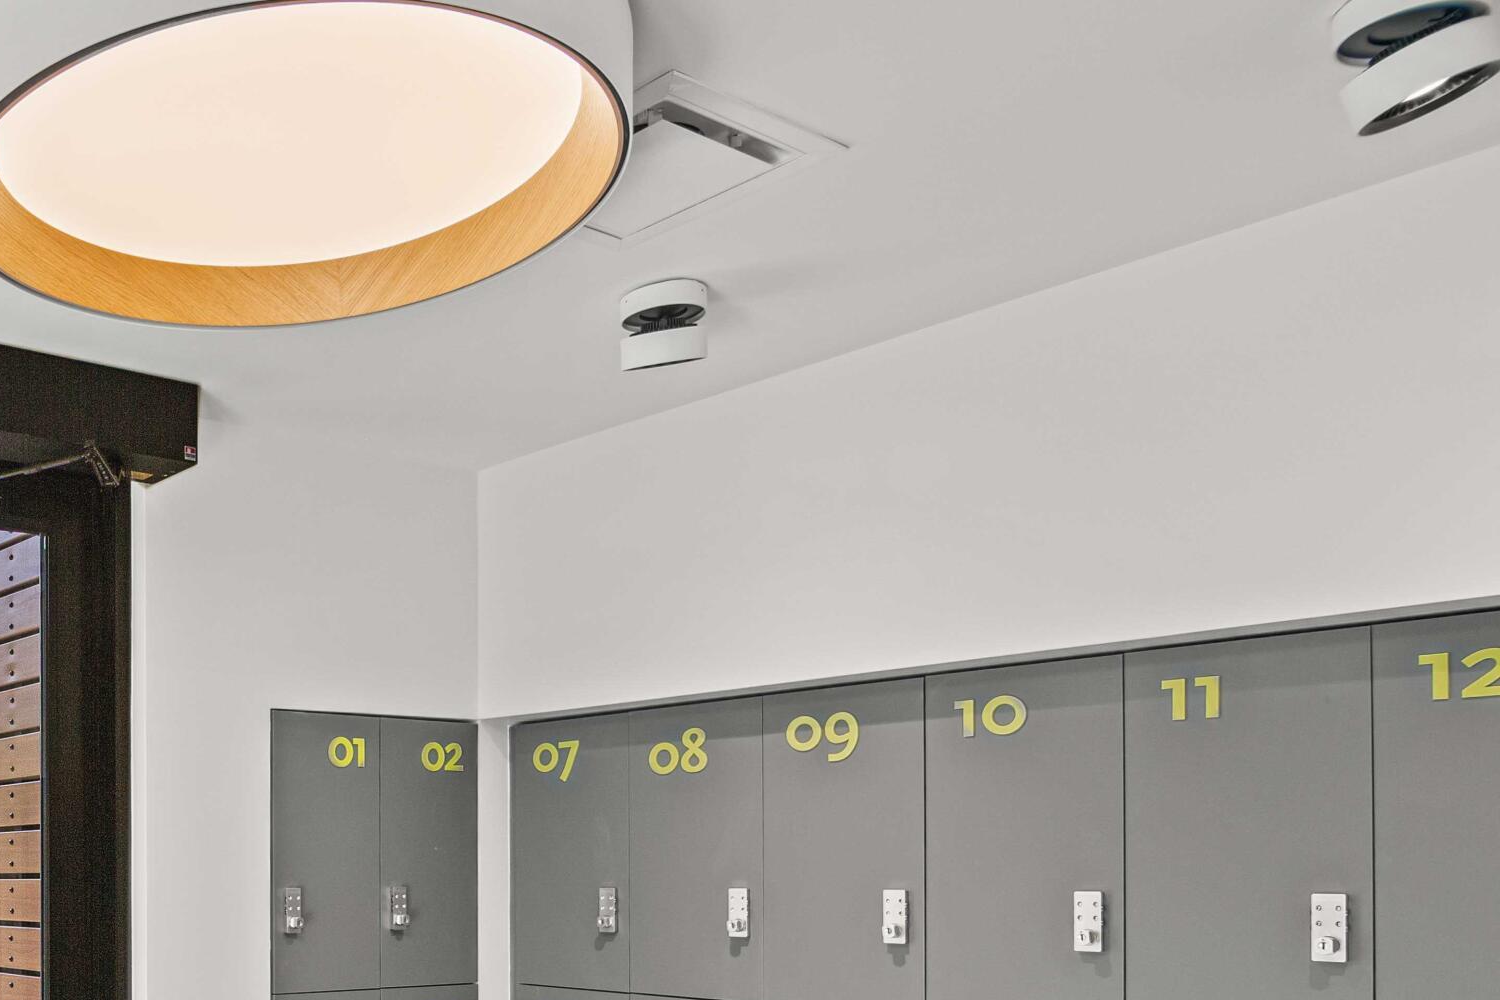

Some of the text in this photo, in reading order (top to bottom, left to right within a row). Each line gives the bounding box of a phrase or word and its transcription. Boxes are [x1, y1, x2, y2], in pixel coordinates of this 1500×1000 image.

[1417, 647, 1500, 701] 12
[954, 694, 1026, 736] 10
[1160, 675, 1221, 721] 11
[327, 736, 366, 768] 01
[420, 741, 464, 772] 02
[648, 726, 707, 776] 08
[787, 713, 860, 763] 09
[532, 739, 580, 782] 07
